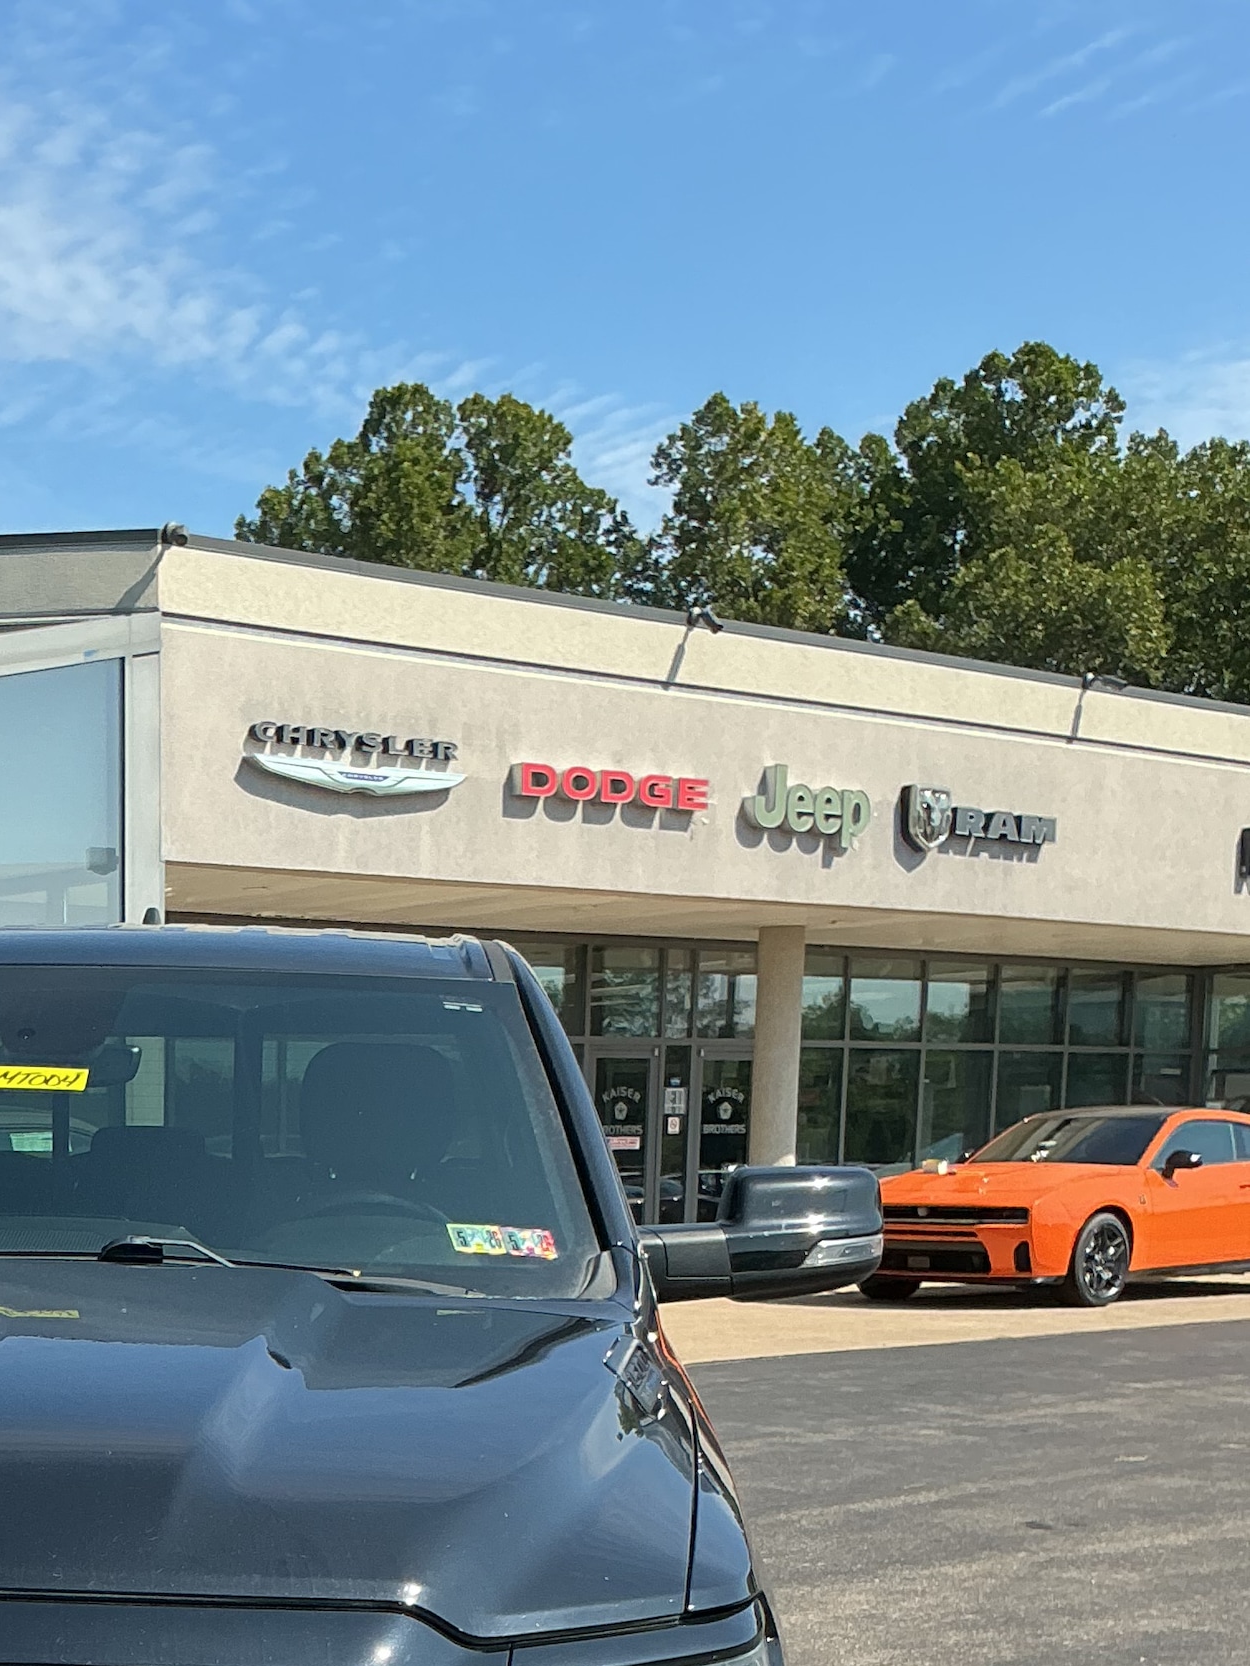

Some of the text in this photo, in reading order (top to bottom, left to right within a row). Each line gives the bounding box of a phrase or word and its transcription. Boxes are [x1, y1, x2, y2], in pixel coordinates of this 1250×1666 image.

[251, 721, 458, 760] CHRYSLER
[521, 762, 709, 811] DODGE
[754, 764, 870, 849] Jeep
[953, 806, 1057, 845] RAM
[602, 1086, 641, 1103] KAISER
[707, 1086, 745, 1104] KAISER
[602, 1124, 643, 1135] ROTHERS
[702, 1123, 746, 1135] BROTHERS
[457, 1230, 467, 1248] 5
[508, 1233, 520, 1250] 5
